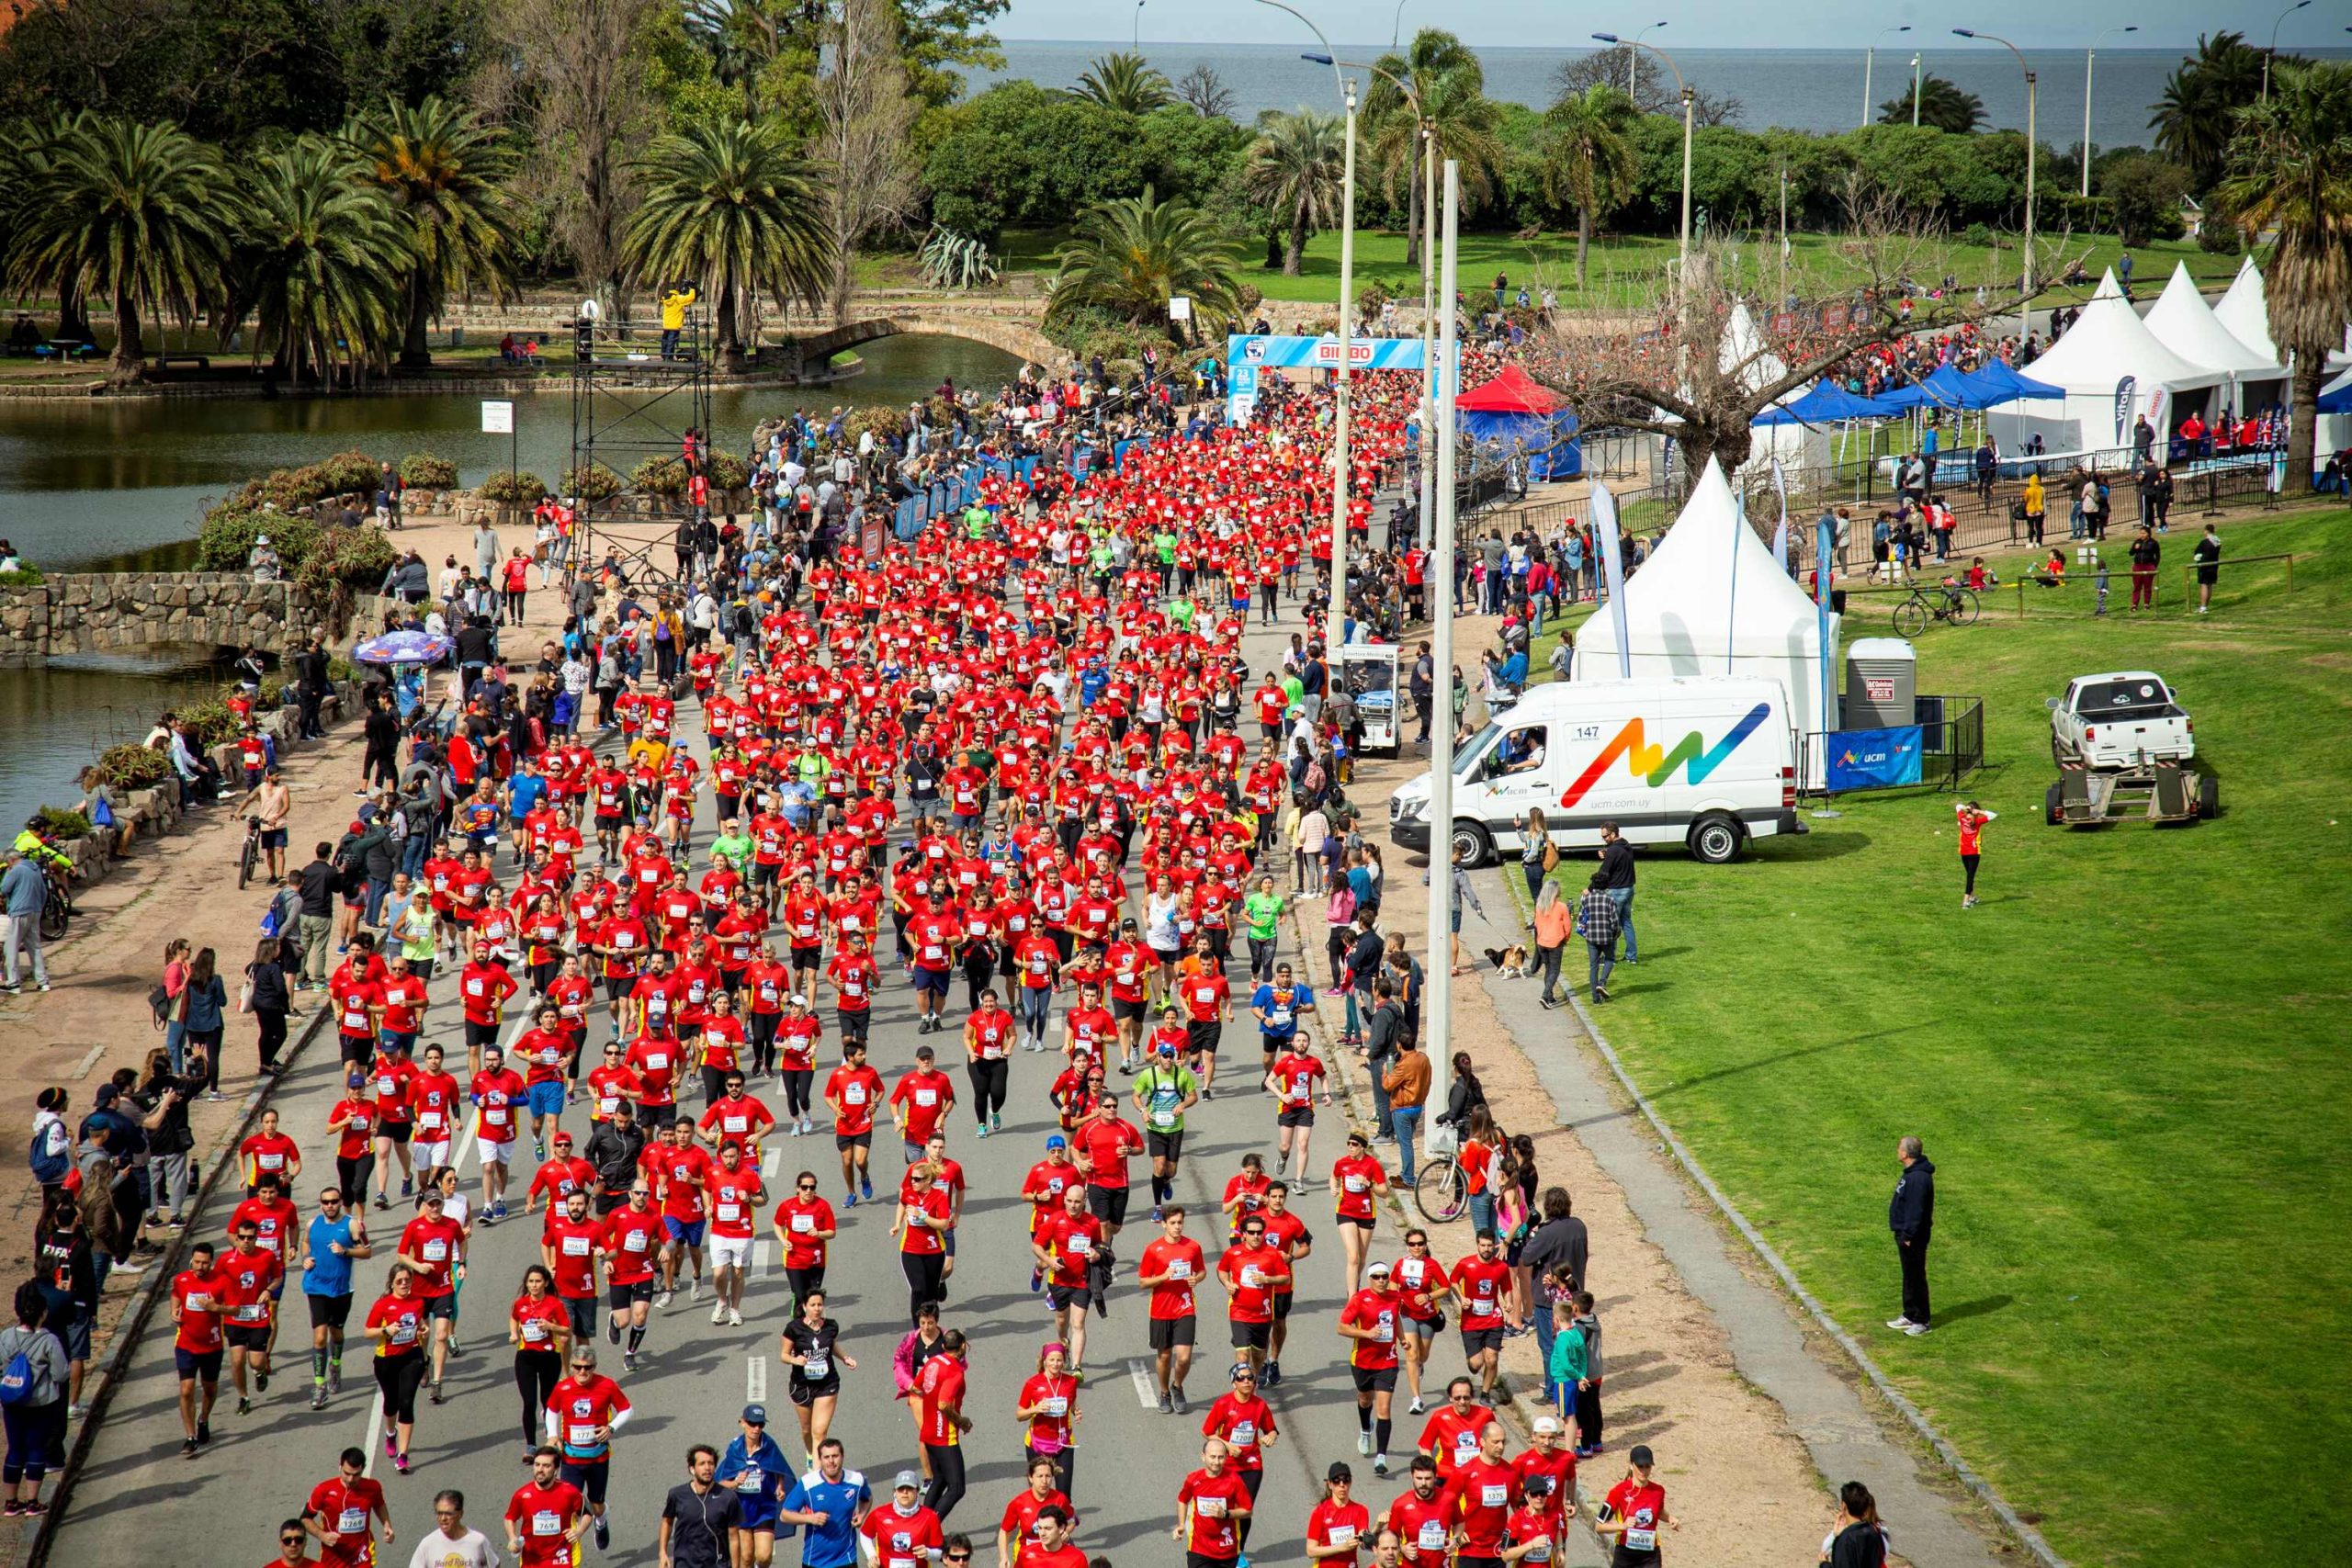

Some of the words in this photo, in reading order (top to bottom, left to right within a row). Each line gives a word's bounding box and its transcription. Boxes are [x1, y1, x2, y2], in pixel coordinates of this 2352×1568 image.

[1320, 346, 1370, 359] BIBO
[1577, 727, 1600, 738] 147
[1864, 752, 1886, 762] ucm
[1591, 798, 1651, 810] ucm.com.uy
[344, 1519, 363, 1528] 1269
[539, 1522, 554, 1530] 769
[1532, 1550, 1546, 1558] 908
